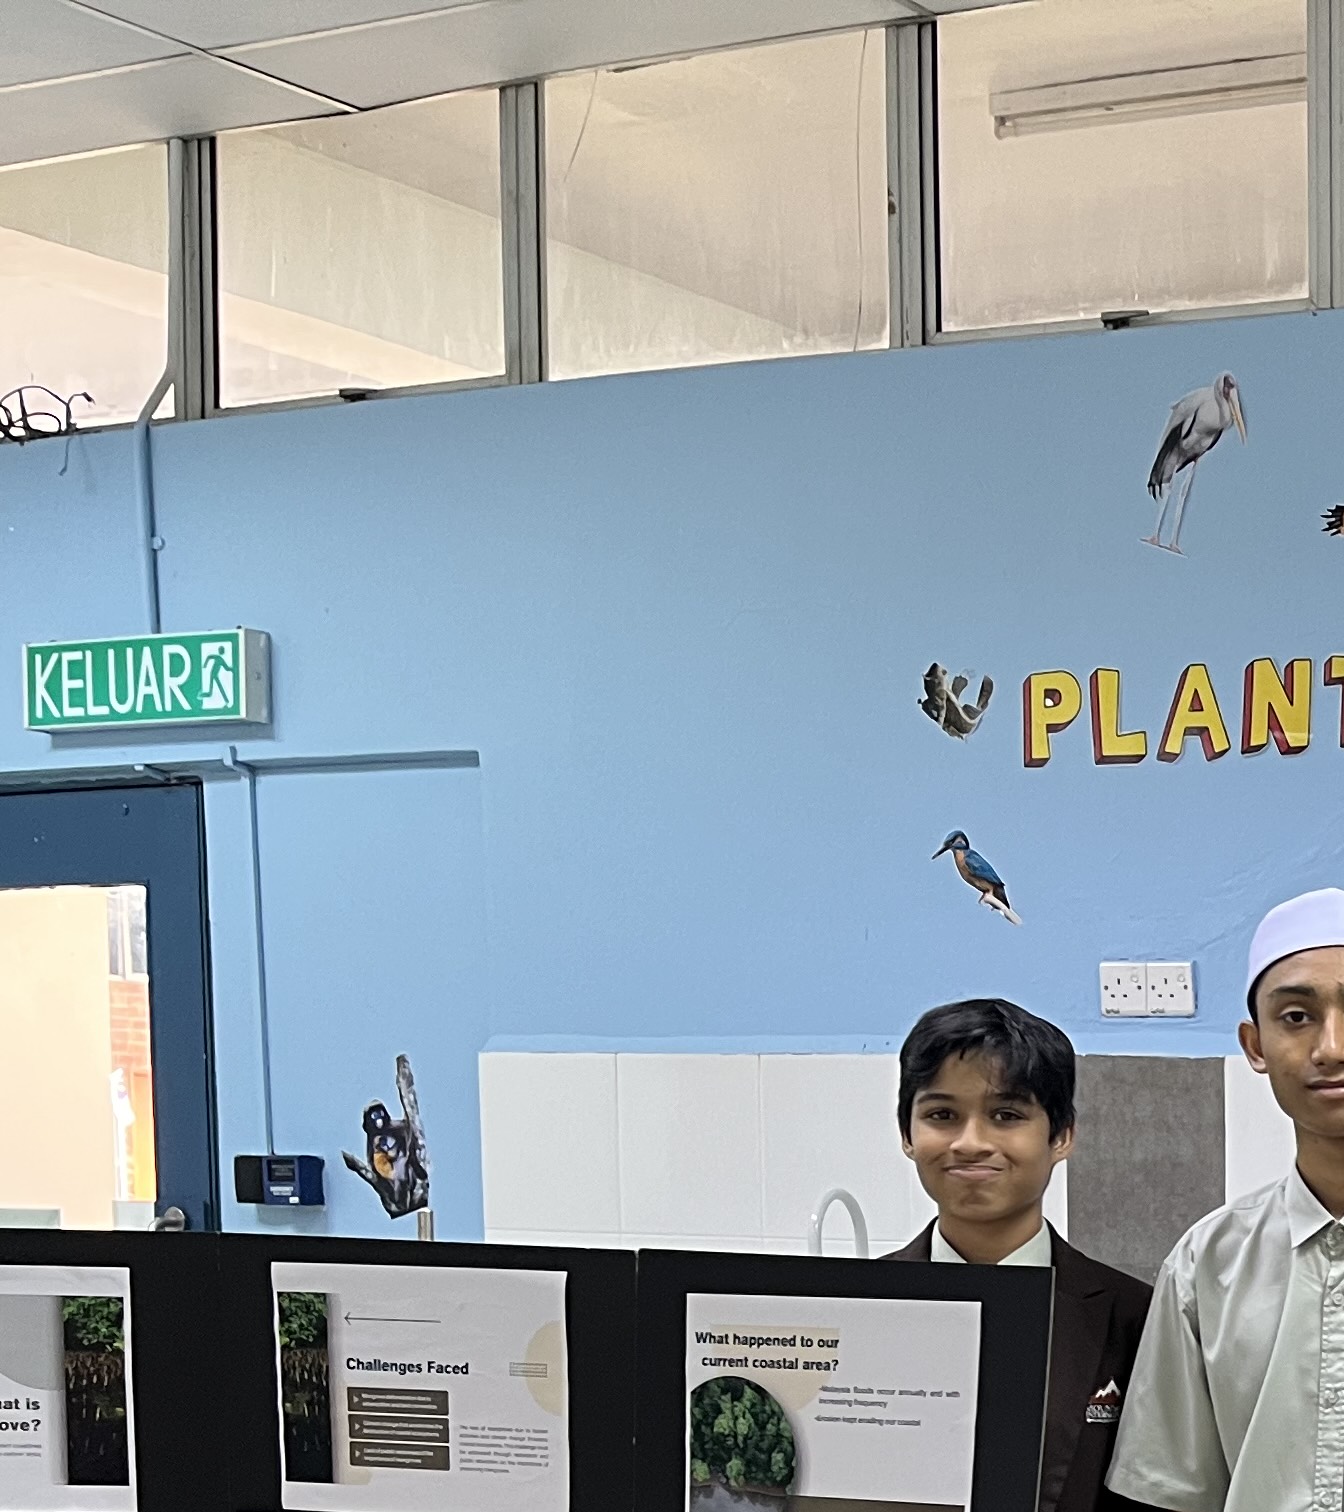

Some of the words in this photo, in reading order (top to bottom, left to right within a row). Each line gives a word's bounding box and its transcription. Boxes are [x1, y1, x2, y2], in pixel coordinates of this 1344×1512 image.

[34, 644, 193, 719] KELUAR
[694, 1331, 730, 1346] What
[732, 1333, 797, 1349] happened
[800, 1335, 814, 1348] to
[817, 1337, 840, 1349] our
[346, 1357, 423, 1375] Challenges
[427, 1361, 470, 1375] Faced
[701, 1355, 749, 1368] current
[752, 1356, 798, 1370] coastal
[802, 1359, 840, 1372] area?
[26, 1397, 41, 1411] is
